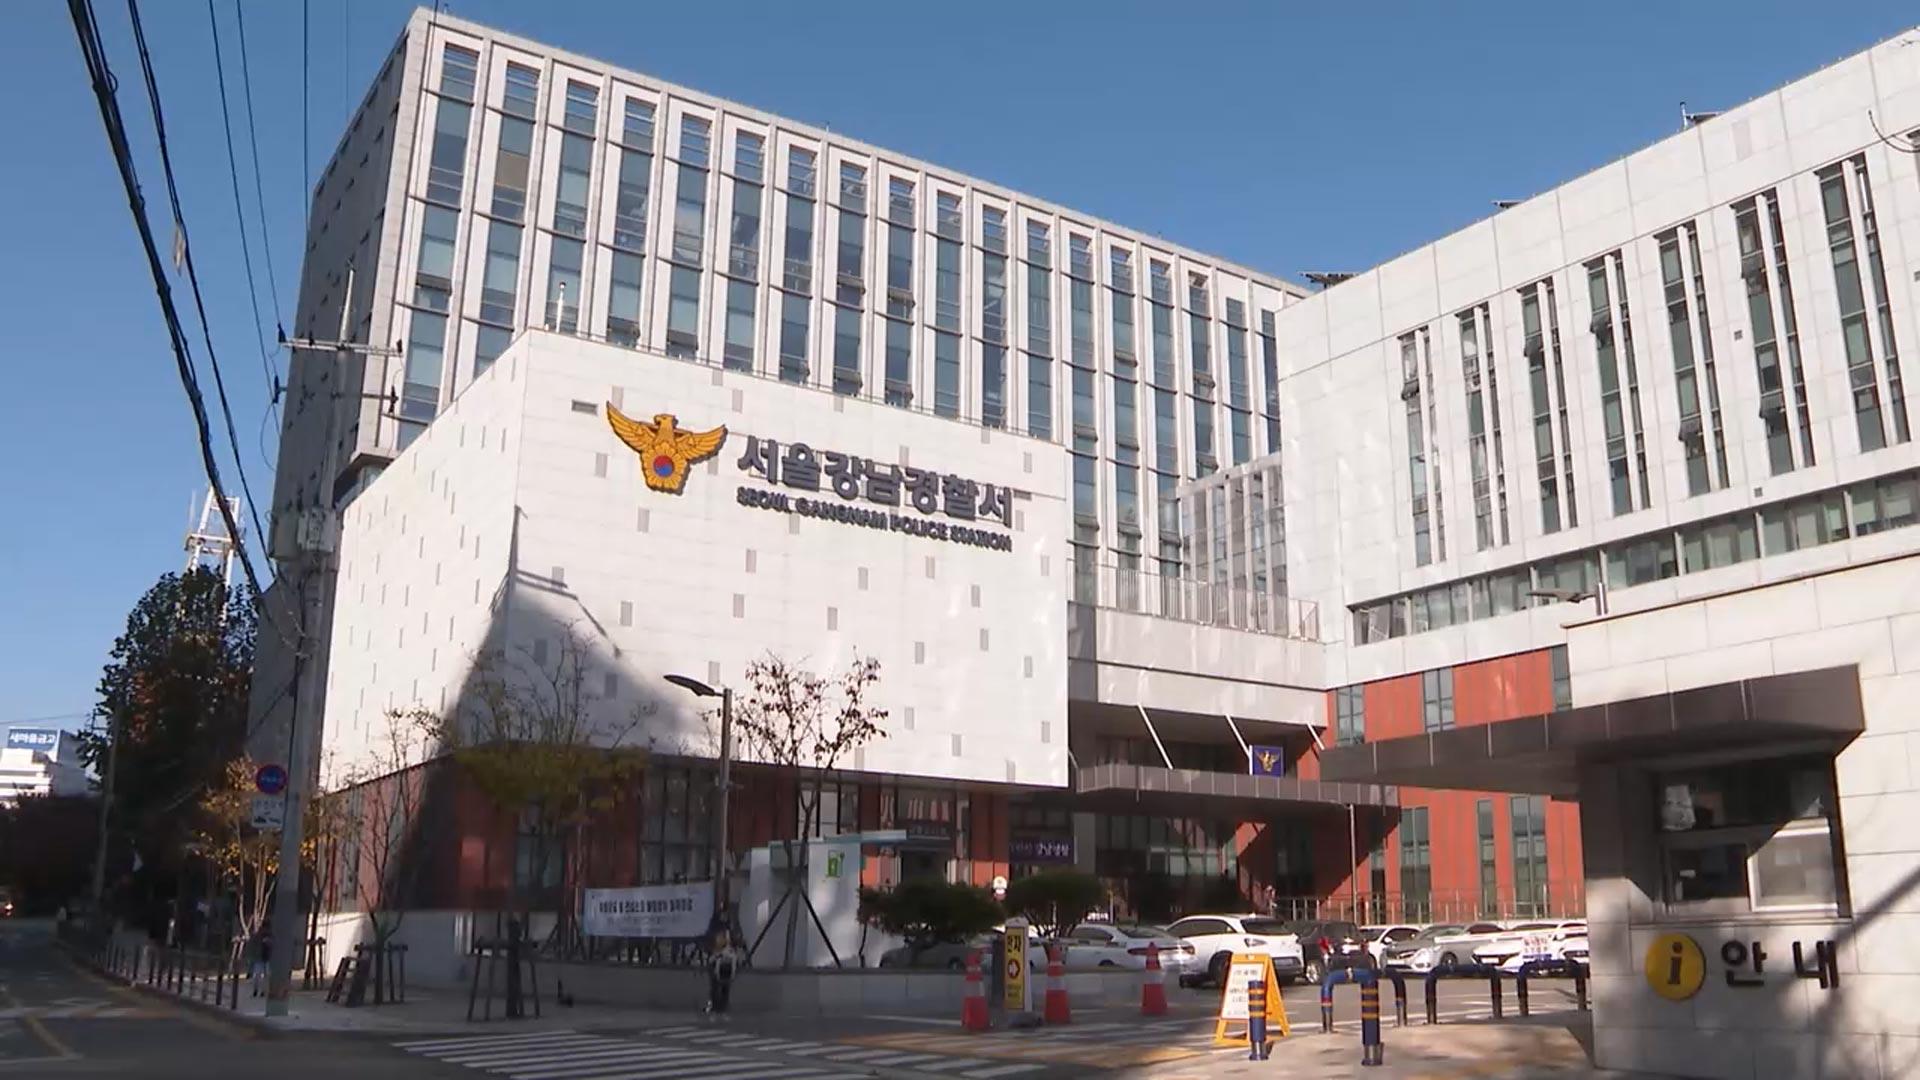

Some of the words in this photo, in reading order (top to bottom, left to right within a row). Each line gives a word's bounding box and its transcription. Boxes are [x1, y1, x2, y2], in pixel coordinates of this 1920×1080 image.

[737, 435, 1013, 527] 서울강남경찰서
[737, 487, 791, 513] SEOUL
[796, 498, 886, 529] GANGNAM
[890, 515, 947, 541] POLICE
[951, 526, 1012, 551] STATION
[1721, 940, 1839, 988] 안내
